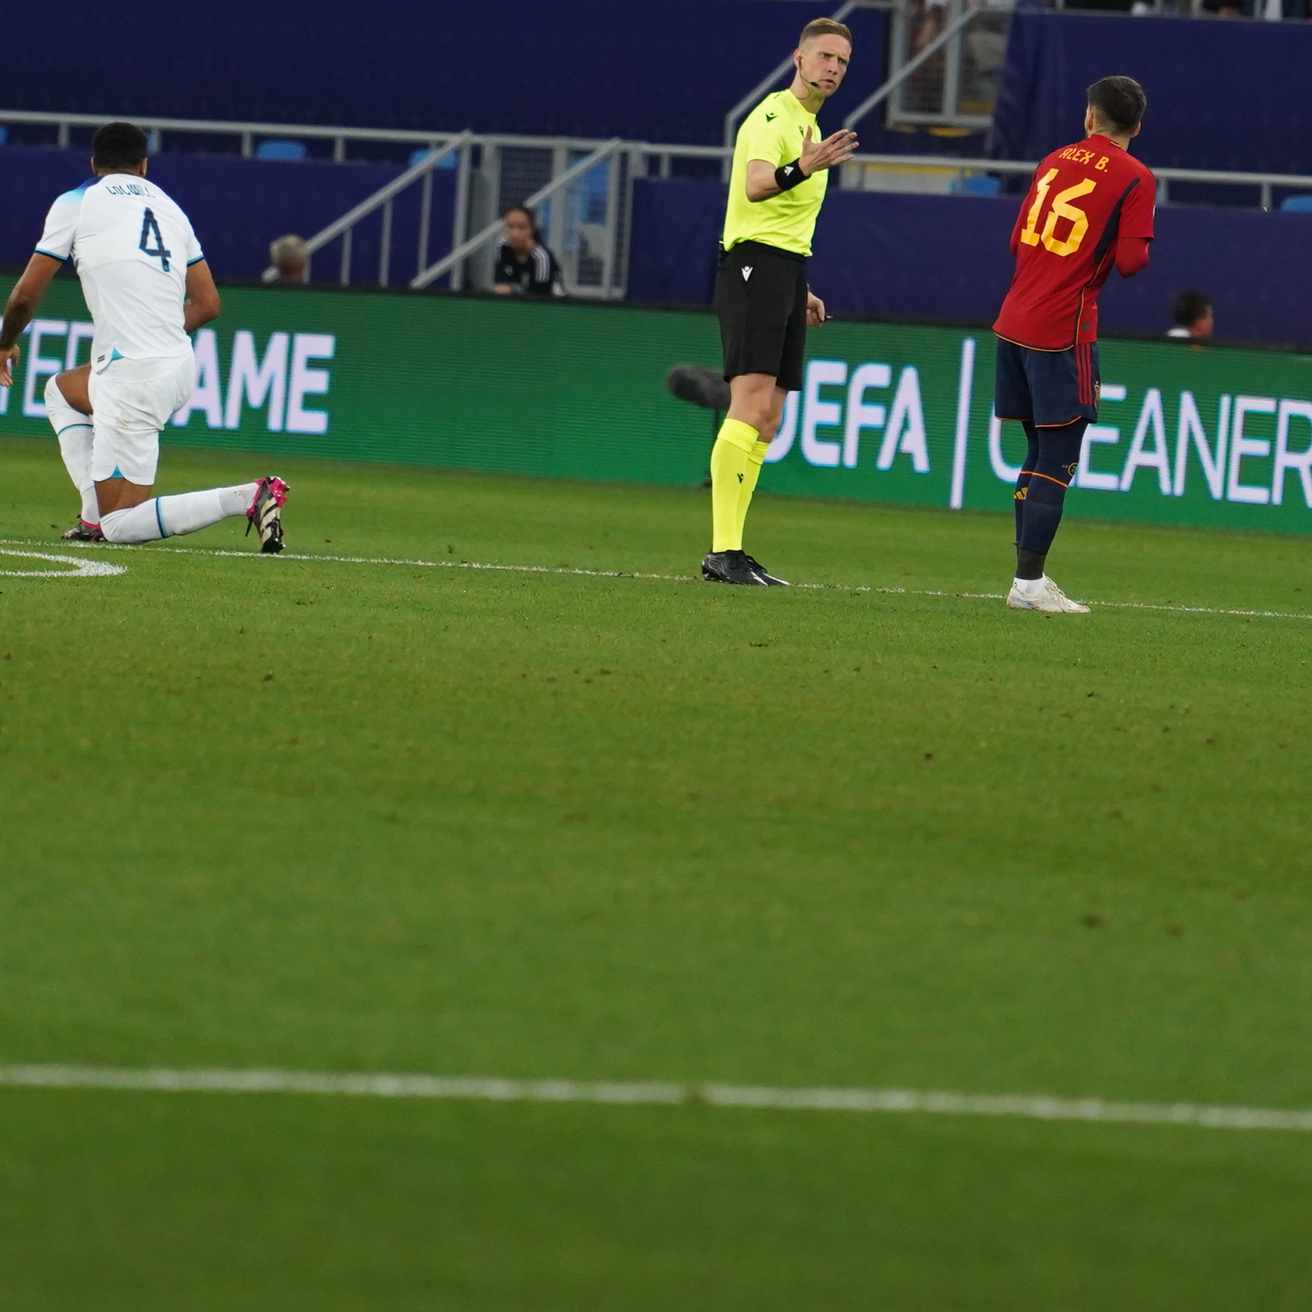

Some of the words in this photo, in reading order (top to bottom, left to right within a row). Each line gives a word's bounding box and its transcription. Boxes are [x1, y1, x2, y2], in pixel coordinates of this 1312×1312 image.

[1058, 147, 1096, 165] ALEX
[1094, 156, 1110, 173] B.
[138, 206, 171, 272] 4
[1020, 168, 1097, 257] 16
[169, 328, 337, 435] AME
